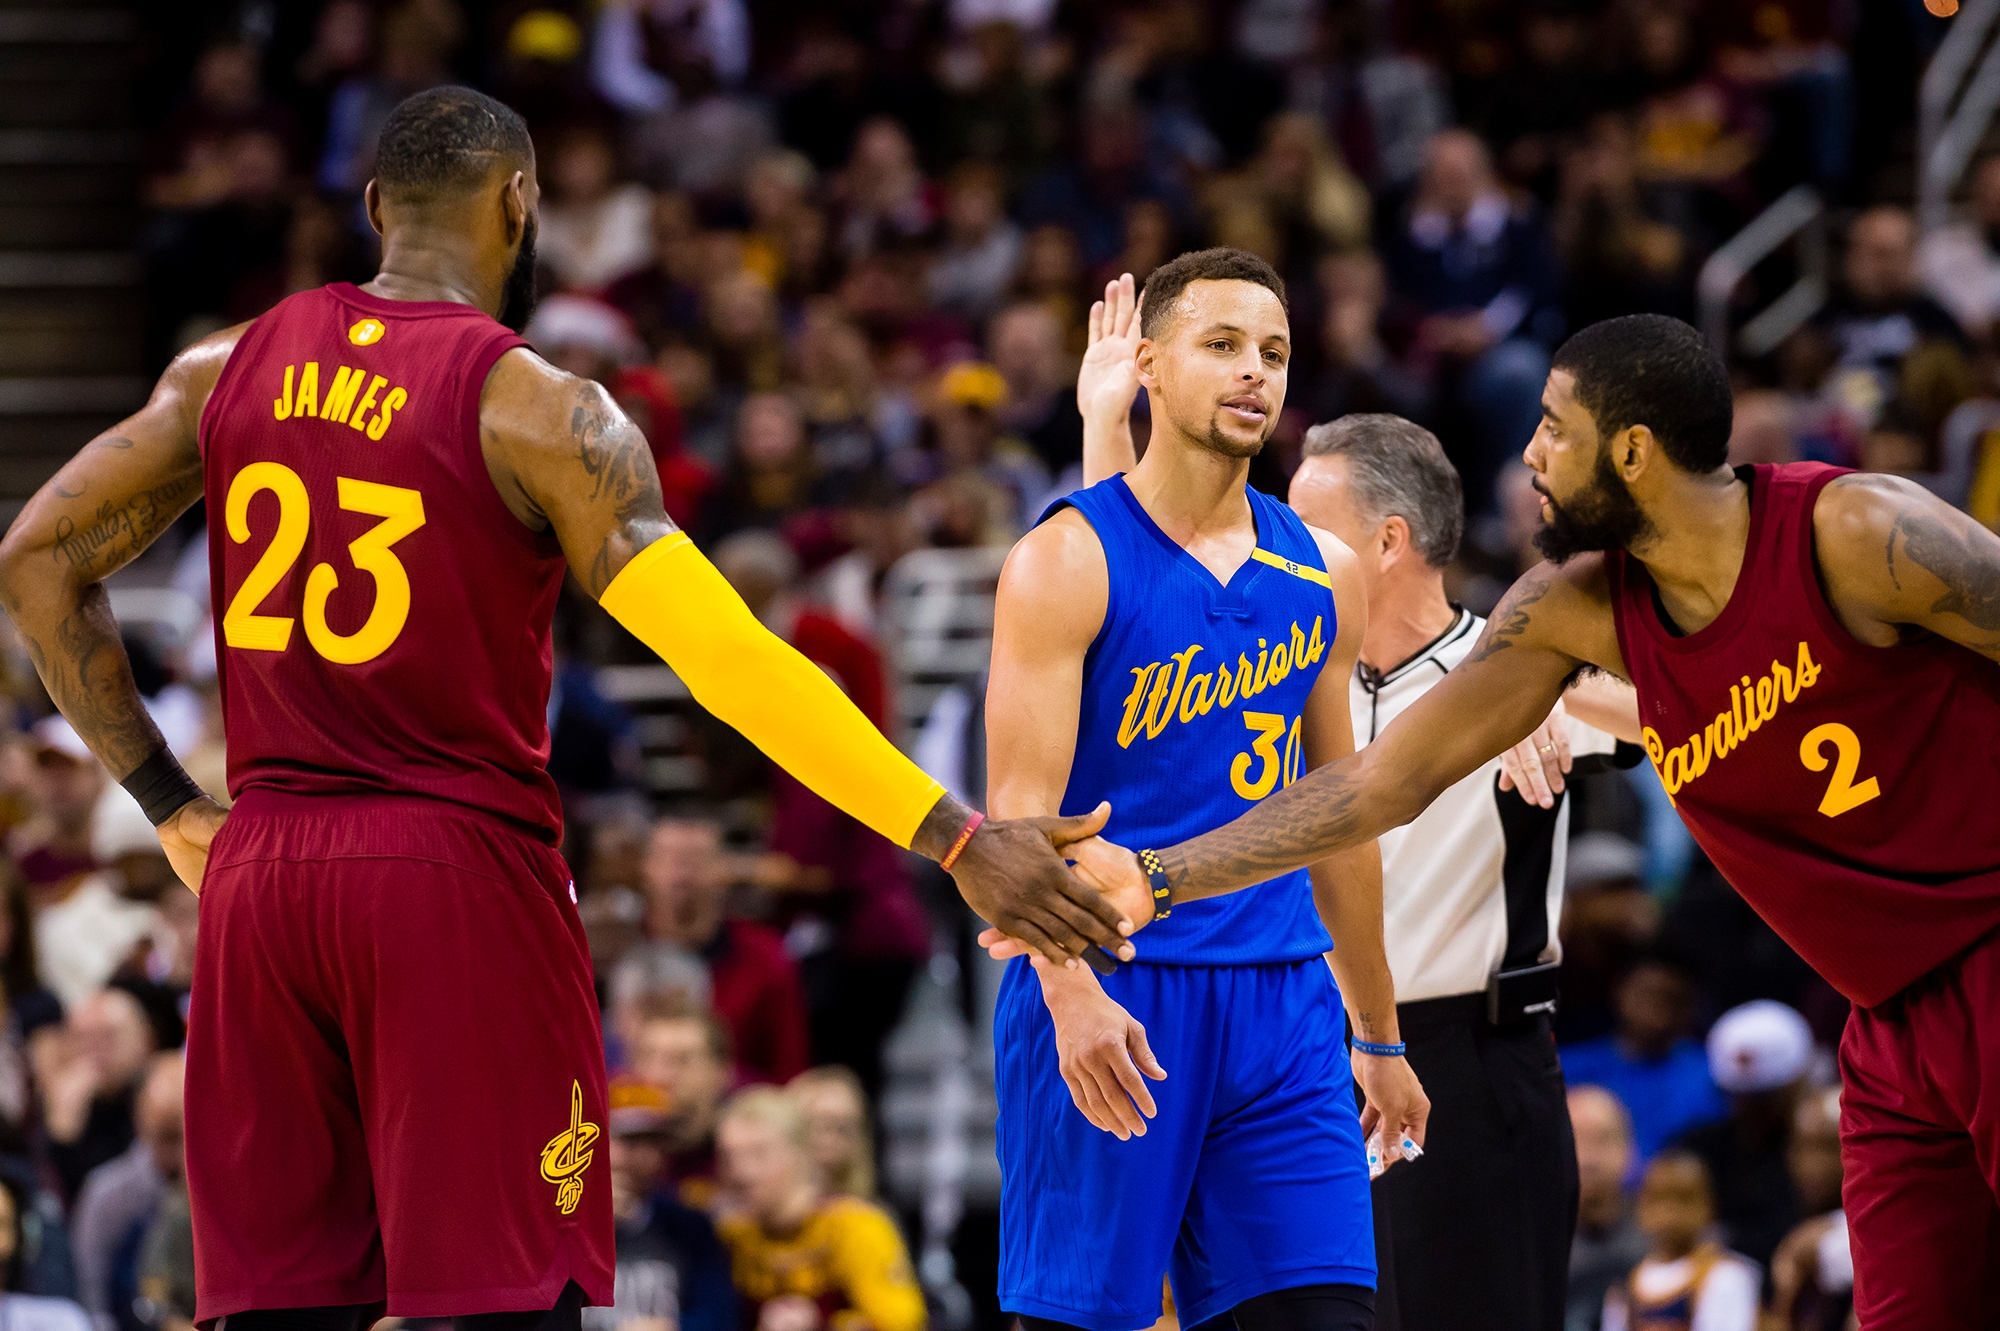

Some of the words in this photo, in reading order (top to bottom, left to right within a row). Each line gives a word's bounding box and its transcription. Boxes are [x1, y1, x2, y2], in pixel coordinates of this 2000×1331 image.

[273, 361, 408, 441] JAMES
[223, 461, 427, 665] 23
[1285, 561, 1299, 575] 42
[1116, 615, 1327, 750] Warriors
[1642, 640, 1822, 808] Cavaliers
[1229, 711, 1303, 801] 30
[1799, 722, 1881, 818] 2
